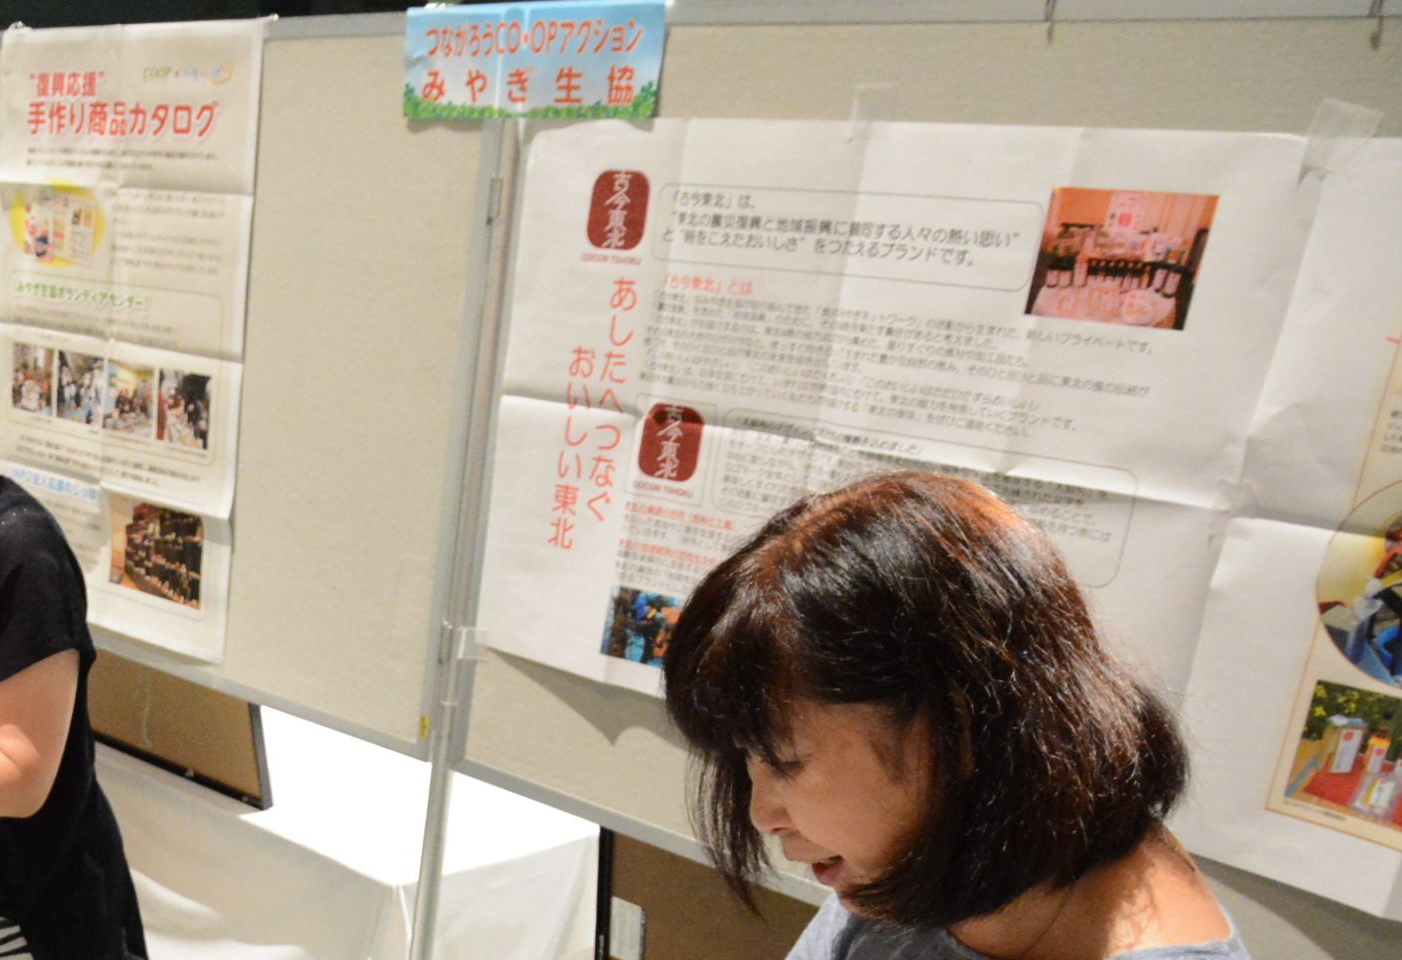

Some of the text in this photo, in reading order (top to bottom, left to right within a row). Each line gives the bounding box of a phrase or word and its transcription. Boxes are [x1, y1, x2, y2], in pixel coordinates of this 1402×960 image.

[27, 101, 220, 137] 手作り商品カタログ
[421, 65, 636, 107] みやぎ生協
[547, 345, 597, 551] おいしい東北
[585, 276, 639, 522] あしたへつなぐ
